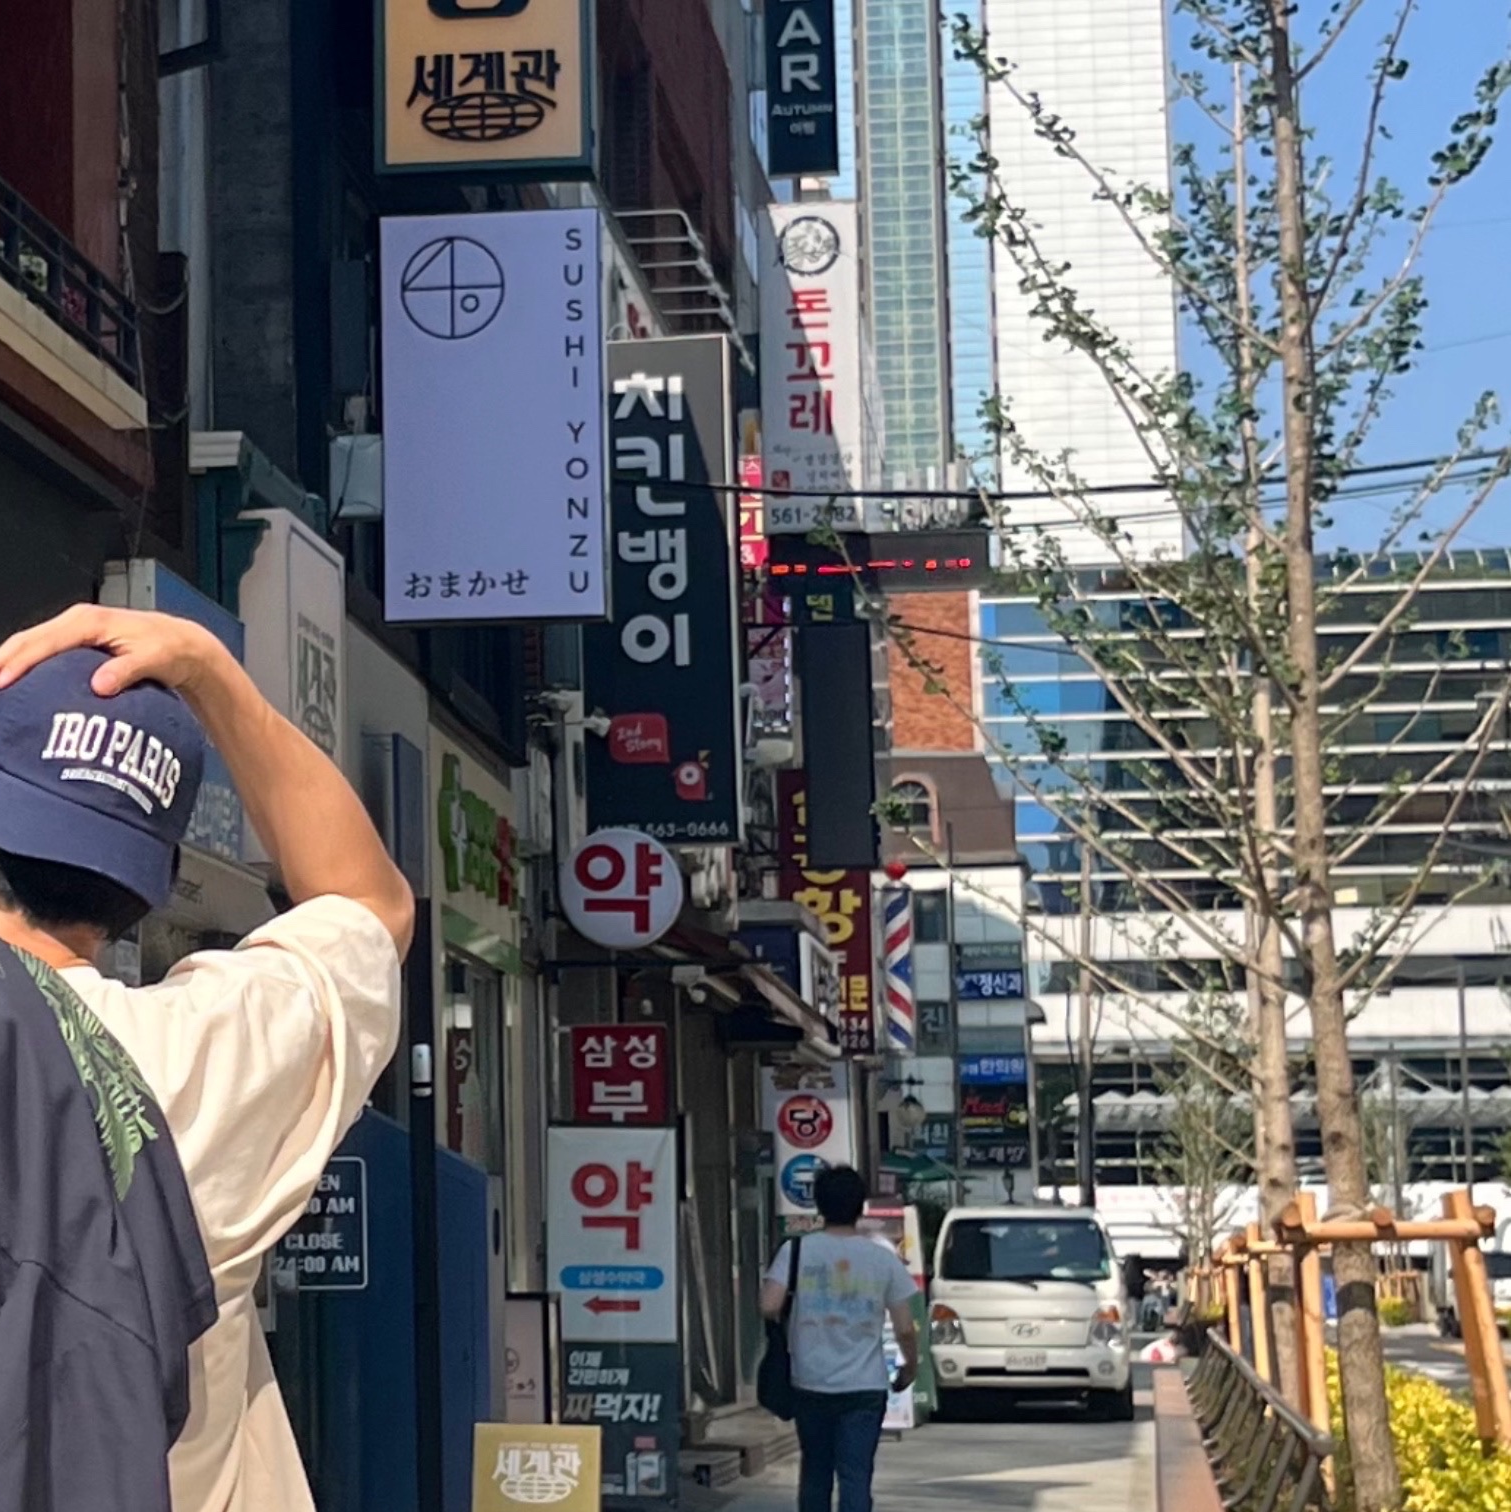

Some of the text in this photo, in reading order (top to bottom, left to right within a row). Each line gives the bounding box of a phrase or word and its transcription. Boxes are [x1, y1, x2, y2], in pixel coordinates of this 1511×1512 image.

[776, 0, 822, 93] AR
[406, 49, 561, 109] 세계관
[562, 229, 590, 594] SUSHI YONZU
[612, 371, 691, 667] 치킨뱅이
[403, 569, 530, 600] おまかせ
[101, 720, 181, 810] PARIS
[574, 843, 662, 934] 약
[579, 1034, 658, 1069] 삼성
[317, 1174, 341, 1192] EN
[326, 1197, 355, 1214] AM
[570, 1161, 654, 1251] 약
[285, 1233, 344, 1250] CLOSE
[331, 1256, 361, 1273] AM
